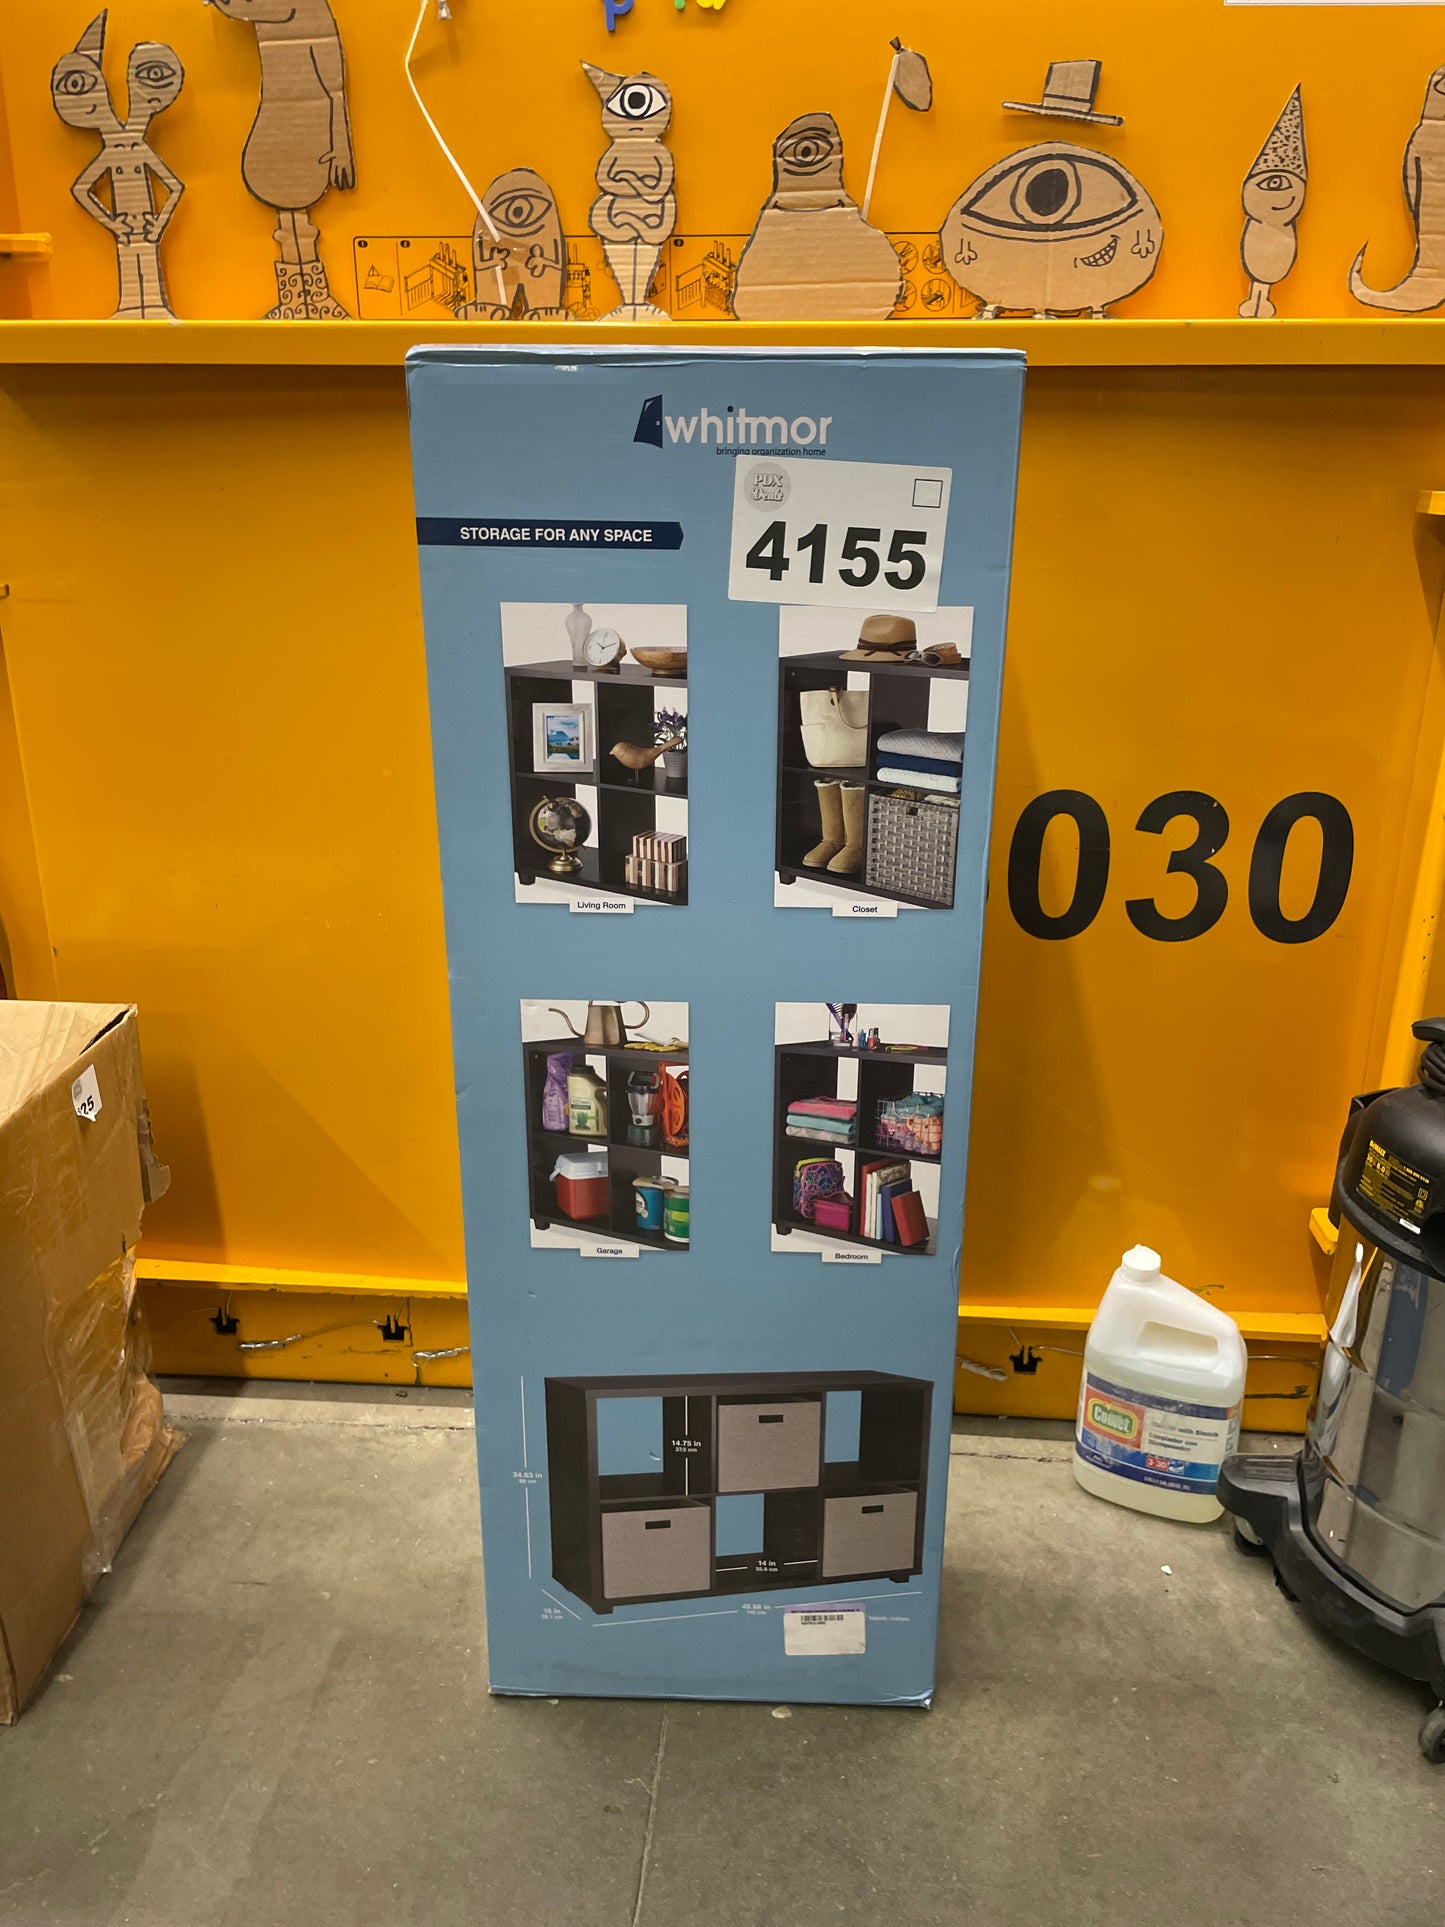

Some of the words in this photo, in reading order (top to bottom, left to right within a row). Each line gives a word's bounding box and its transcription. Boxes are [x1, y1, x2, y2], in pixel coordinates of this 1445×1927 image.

[665, 405, 832, 444] whitmor
[716, 446, 750, 457] bringing
[752, 446, 800, 456] organization
[803, 446, 826, 456] home
[753, 473, 784, 488] PDX
[751, 486, 784, 502] Deals
[460, 527, 531, 541] STORAGE
[535, 528, 566, 541] FOR
[569, 528, 600, 542] ANY
[604, 529, 653, 542] SPACE
[746, 520, 928, 590] 4155
[986, 789, 1354, 944] 030
[577, 901, 601, 910] Living
[602, 901, 626, 909] Room
[852, 905, 878, 913] Closet
[596, 1247, 623, 1255] Garage
[834, 1252, 869, 1260] Bedroom
[1093, 1406, 1131, 1434] Comet
